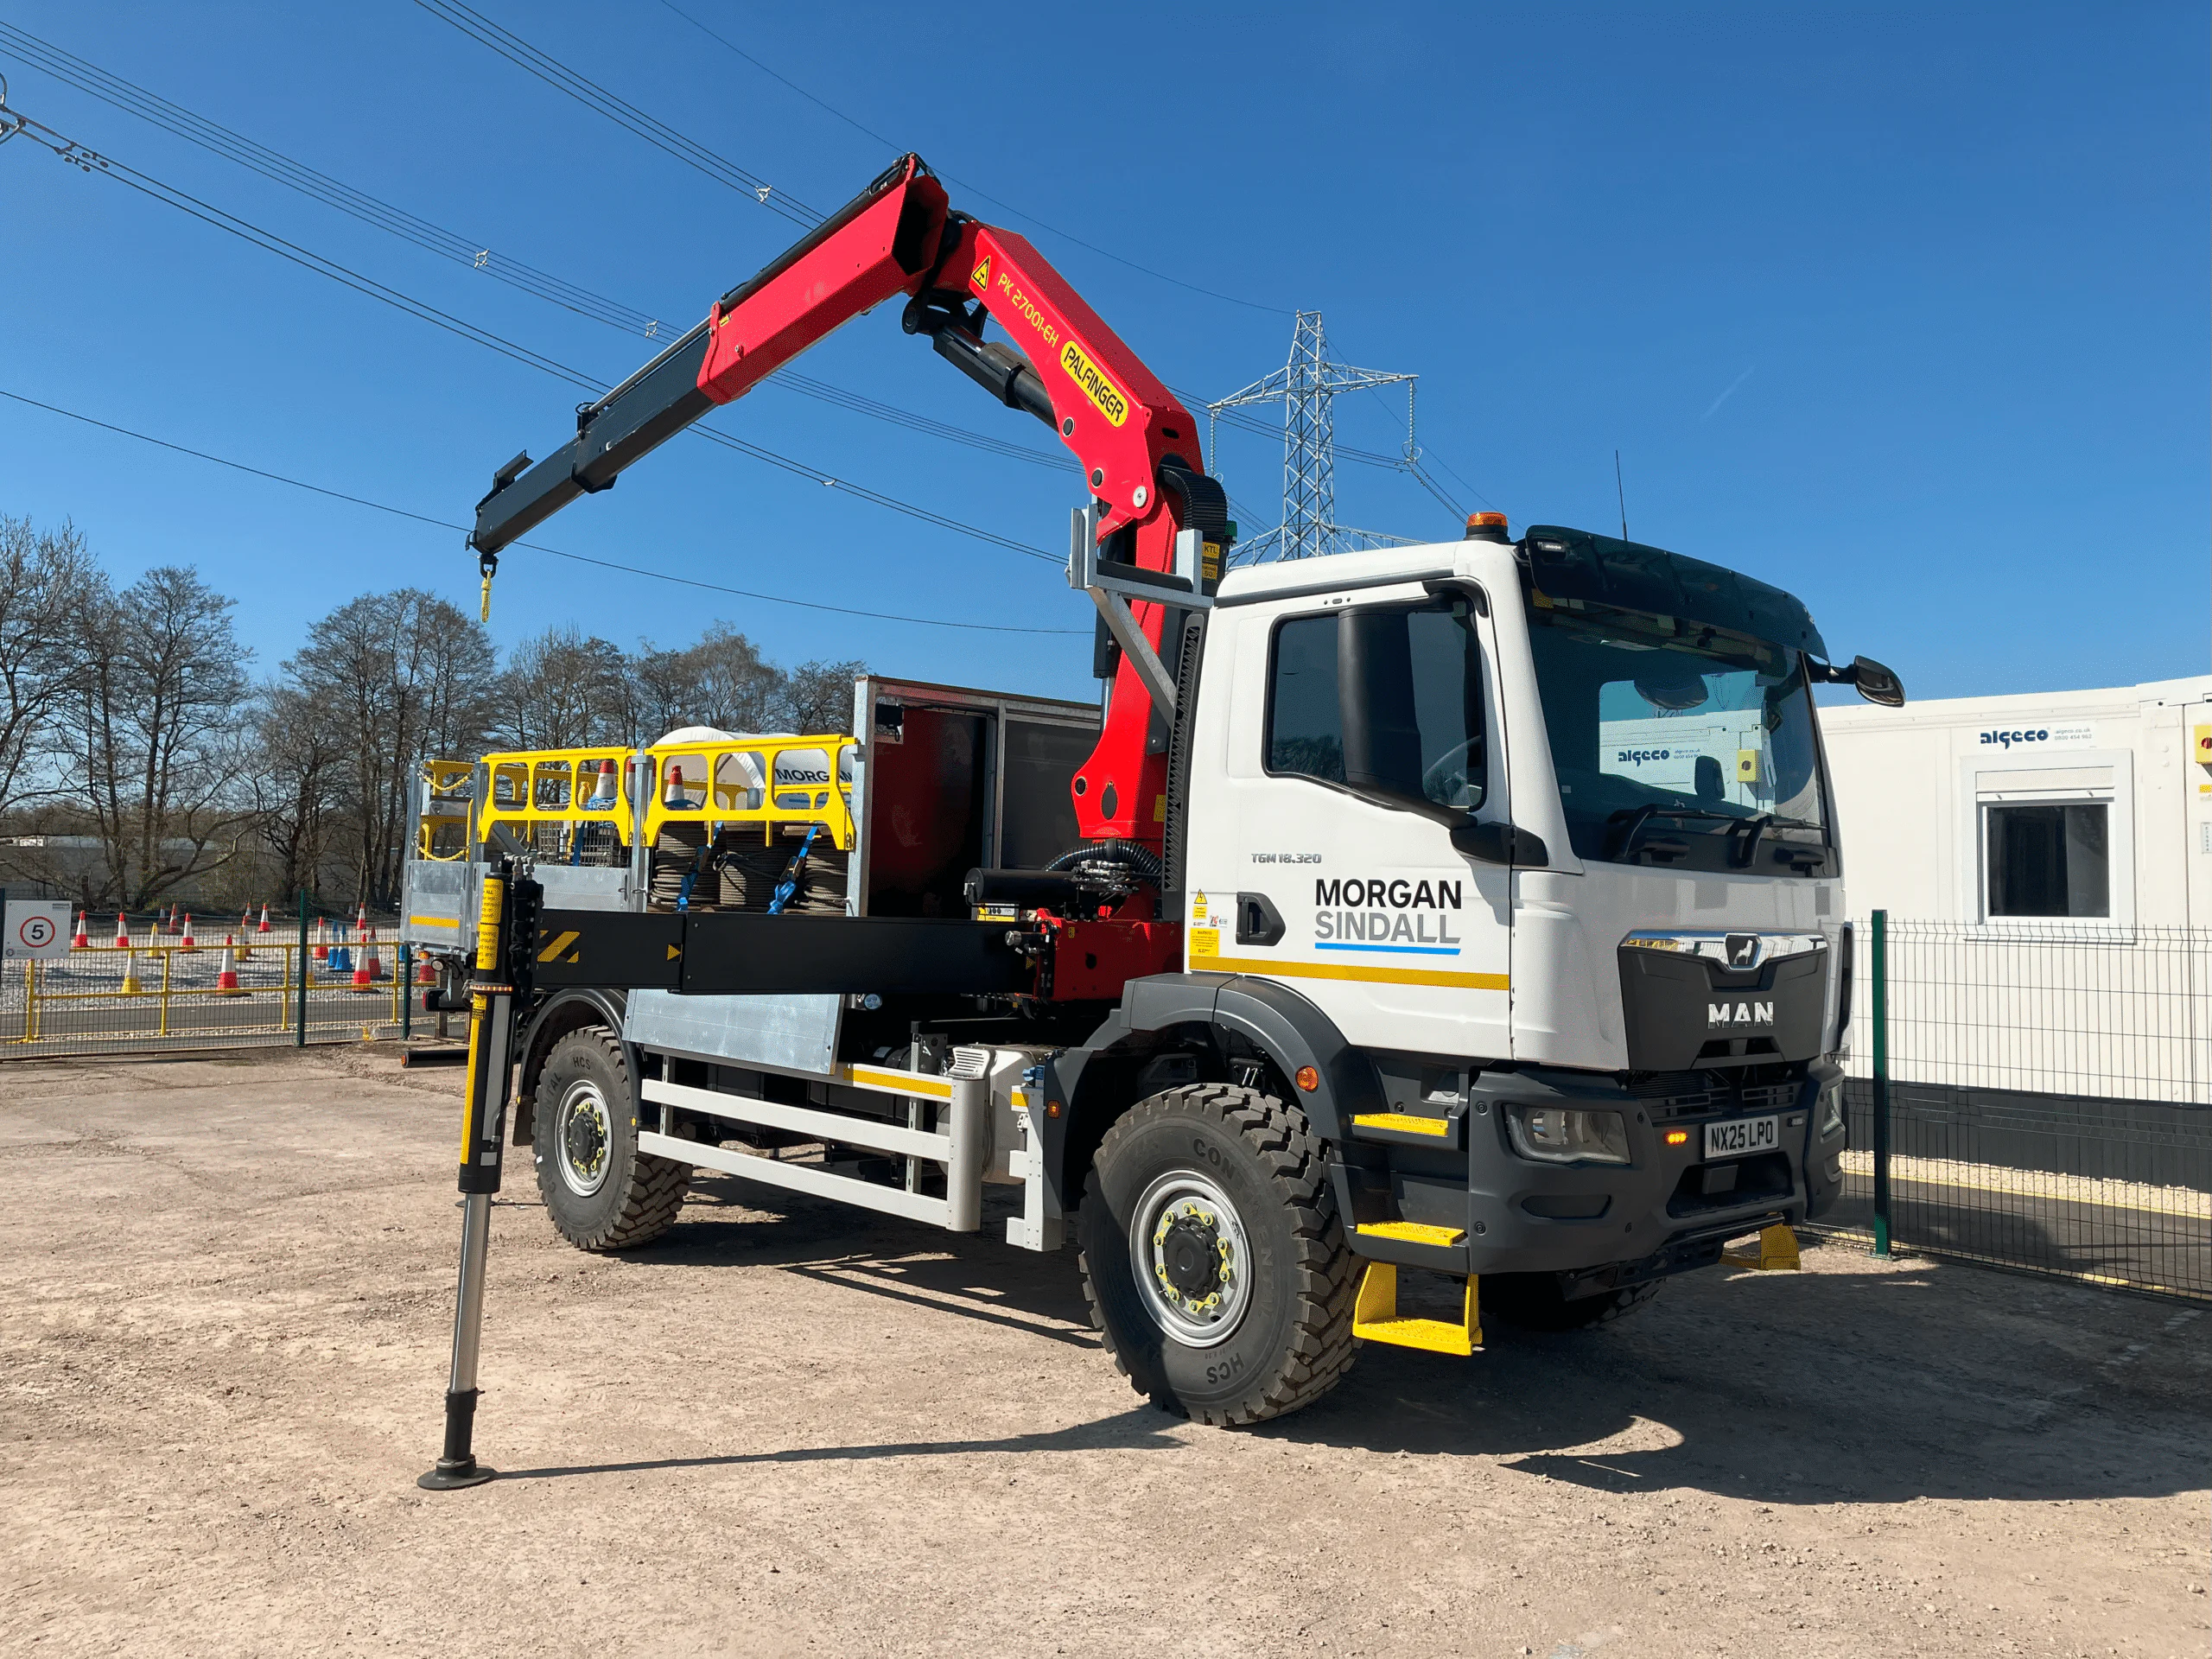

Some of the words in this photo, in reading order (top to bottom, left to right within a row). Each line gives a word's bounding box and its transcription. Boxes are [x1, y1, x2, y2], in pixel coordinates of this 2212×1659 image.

[997, 273, 1014, 296] PK
[1064, 346, 1124, 423] PALFINGER
[775, 769, 852, 782] MORGN
[1250, 853, 1276, 863] TGM
[1277, 853, 1322, 864] 18.320
[1315, 879, 1462, 909] MORGAN
[31, 924, 44, 940] 5
[1314, 911, 1461, 944] SINDALL
[1707, 1001, 1774, 1029] MAN
[572, 1056, 591, 1071] HCS
[1711, 1123, 1746, 1153] NX25
[1749, 1120, 1772, 1147] LPO
[1205, 1351, 1245, 1385] HCS
